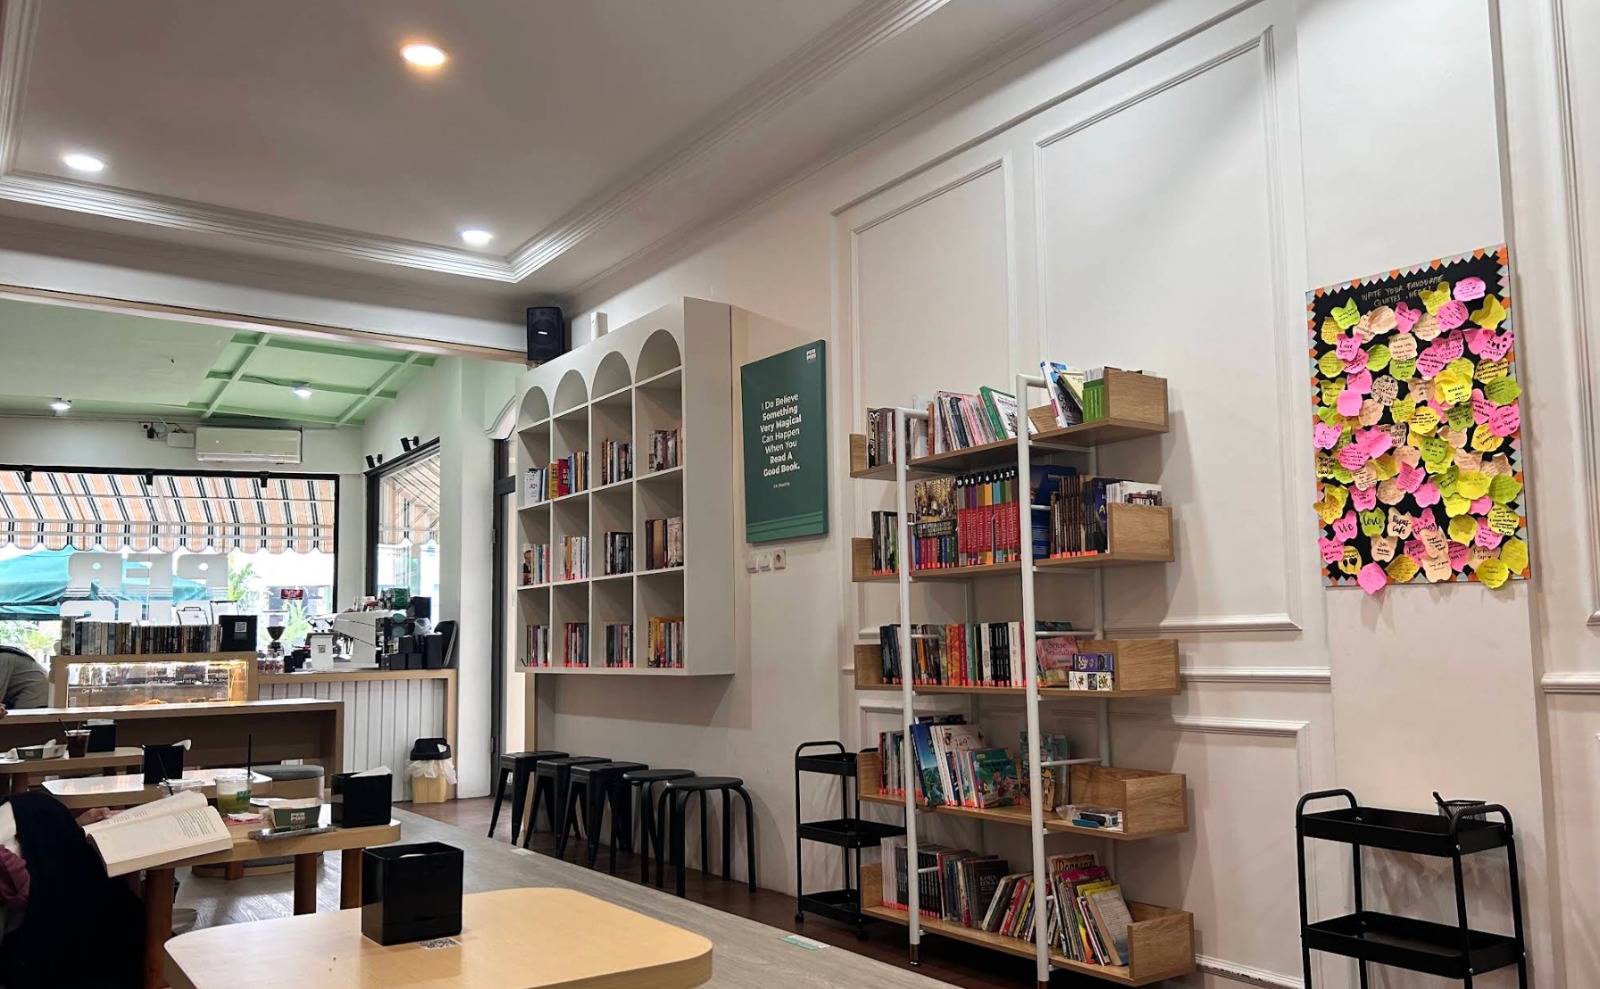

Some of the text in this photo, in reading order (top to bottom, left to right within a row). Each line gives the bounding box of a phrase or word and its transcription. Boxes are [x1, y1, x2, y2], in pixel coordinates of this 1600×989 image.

[1385, 285, 1404, 295] YOUR
[765, 399, 774, 409] Do
[775, 393, 799, 407] Believe
[762, 406, 798, 421] Something
[760, 414, 802, 433] Very Magical
[762, 427, 800, 444] Can Happen
[765, 440, 797, 454] When You
[770, 452, 793, 464] Read A
[763, 462, 800, 477] Good Book.
